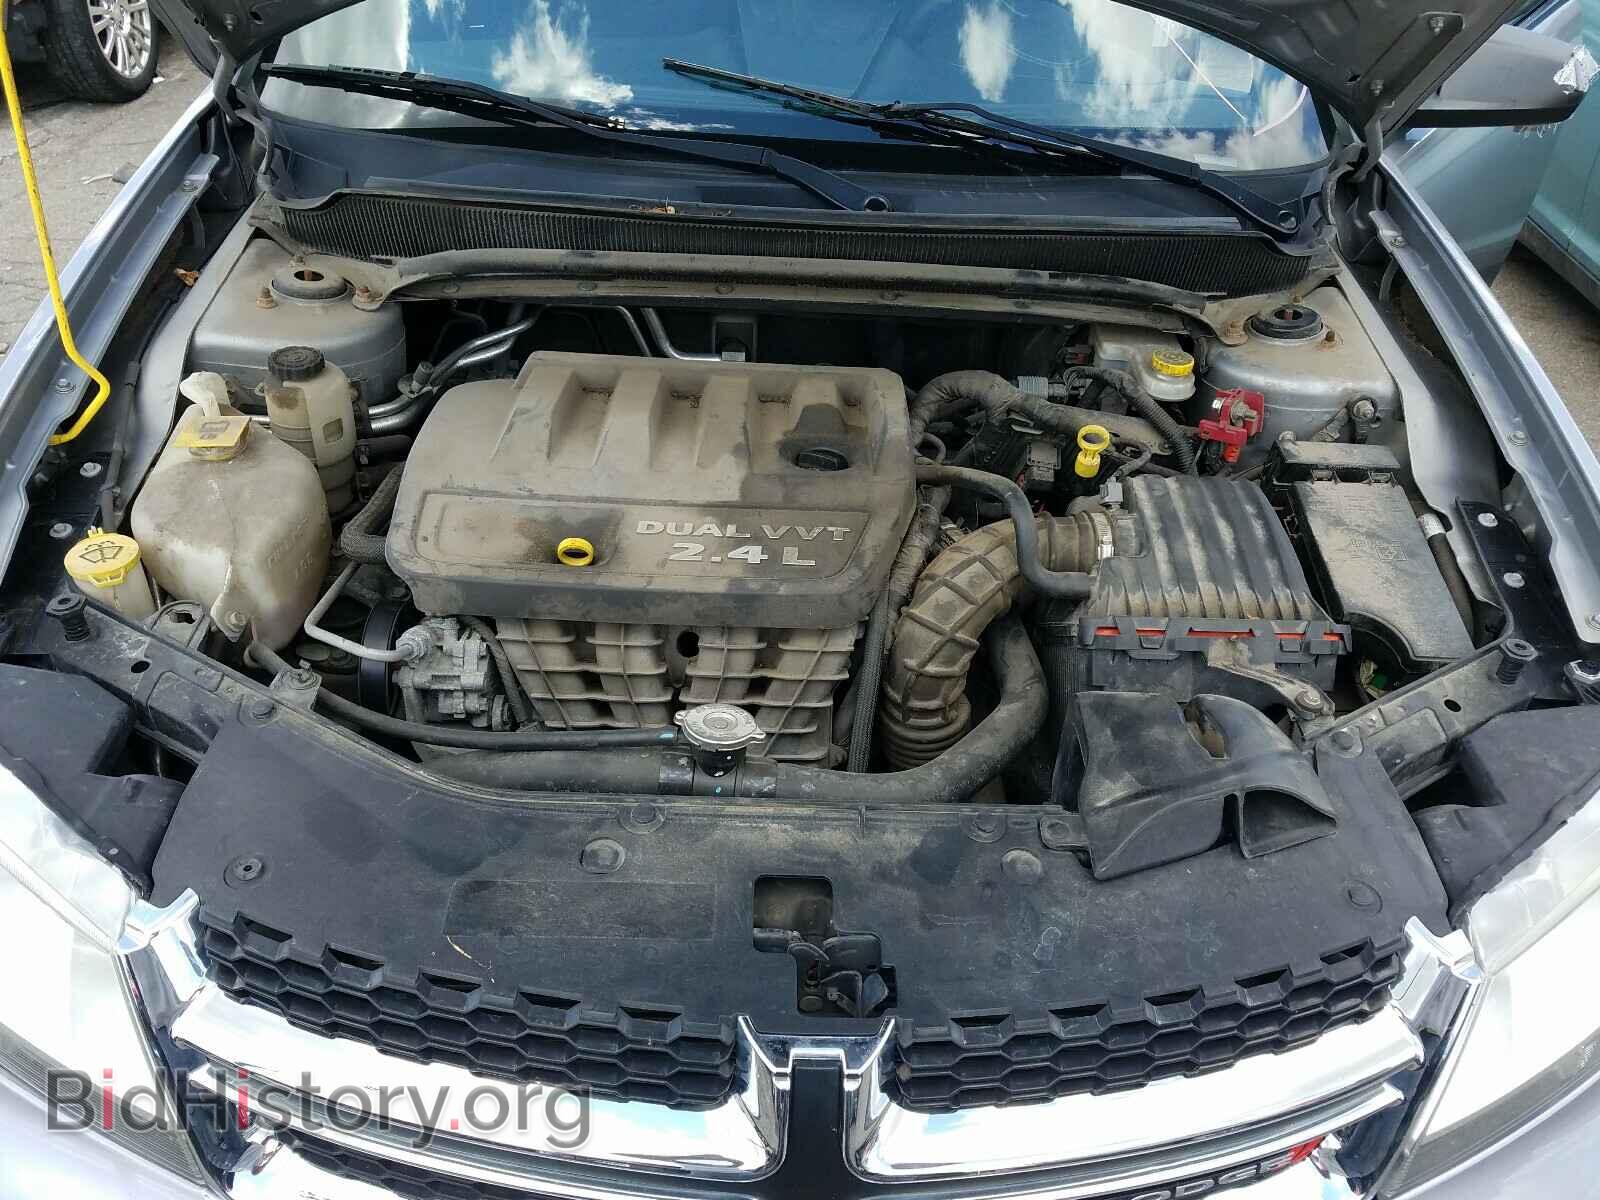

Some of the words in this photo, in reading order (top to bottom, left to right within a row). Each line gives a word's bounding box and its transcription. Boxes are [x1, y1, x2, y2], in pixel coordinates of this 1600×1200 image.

[636, 520, 752, 538] DUAL
[761, 525, 851, 541] VVT
[670, 542, 769, 564] 2.4
[782, 546, 816, 566] L
